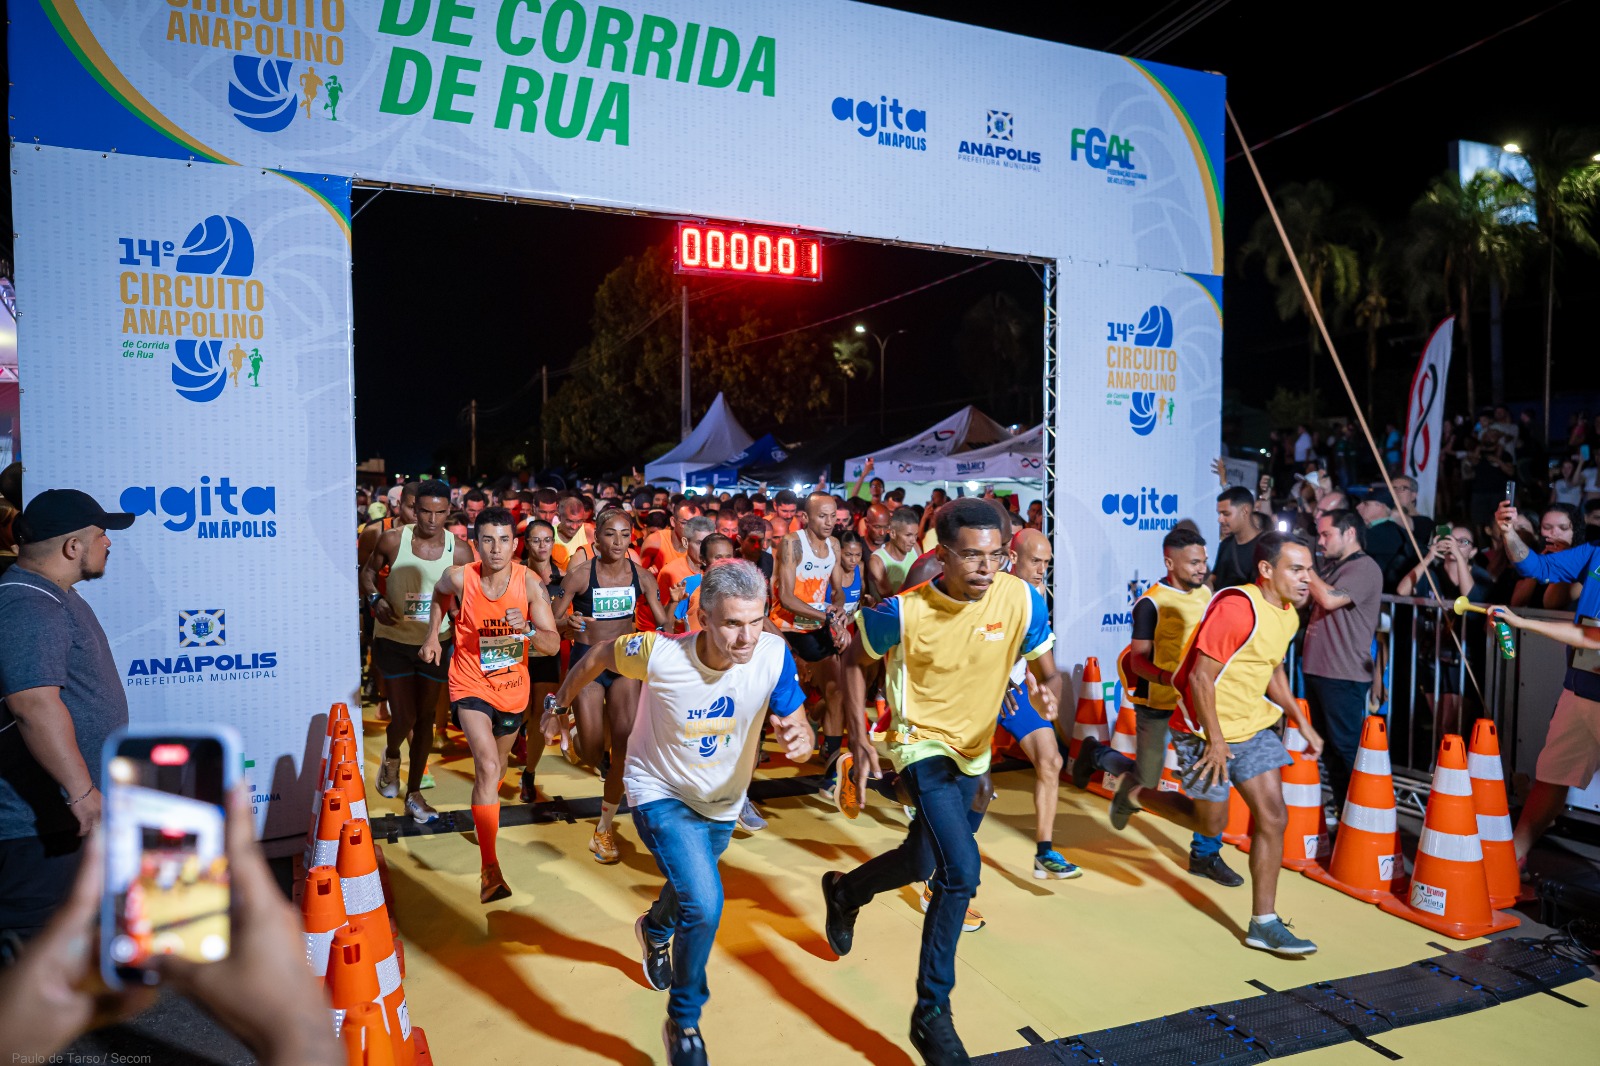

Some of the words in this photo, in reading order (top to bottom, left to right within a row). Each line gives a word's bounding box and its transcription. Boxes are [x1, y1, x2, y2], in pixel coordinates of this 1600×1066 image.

[166, 11, 344, 66] ANAPOLINO
[378, 0, 475, 47] DE
[496, 0, 776, 98] CORRIDA
[379, 46, 482, 125] DE
[494, 64, 629, 146] RUA
[831, 95, 926, 138] agita
[957, 153, 1000, 166] PREFEITURA
[1003, 161, 1041, 172] MUNICIPAL
[958, 140, 1041, 164] ANÁPOLIS
[118, 237, 175, 267] 14º
[119, 271, 265, 312] CIRCUITO
[122, 308, 264, 340] ANAPOLINO
[122, 340, 134, 348] de
[136, 340, 170, 350] Corrida
[122, 350, 134, 358] de
[137, 350, 154, 359] Rua
[1106, 345, 1177, 372] CIRCUITO
[1107, 370, 1176, 392] ANAPOLINO
[119, 475, 276, 532] agita
[1102, 486, 1178, 526] agita
[196, 519, 277, 539] ANÁPOLIS
[408, 602, 432, 612] 432
[598, 598, 626, 610] 1181
[127, 651, 278, 677] ANÁPOLIS
[485, 645, 518, 660] 4257
[127, 674, 204, 687] PREFEITURA
[210, 670, 277, 682] MUNICIPAL
